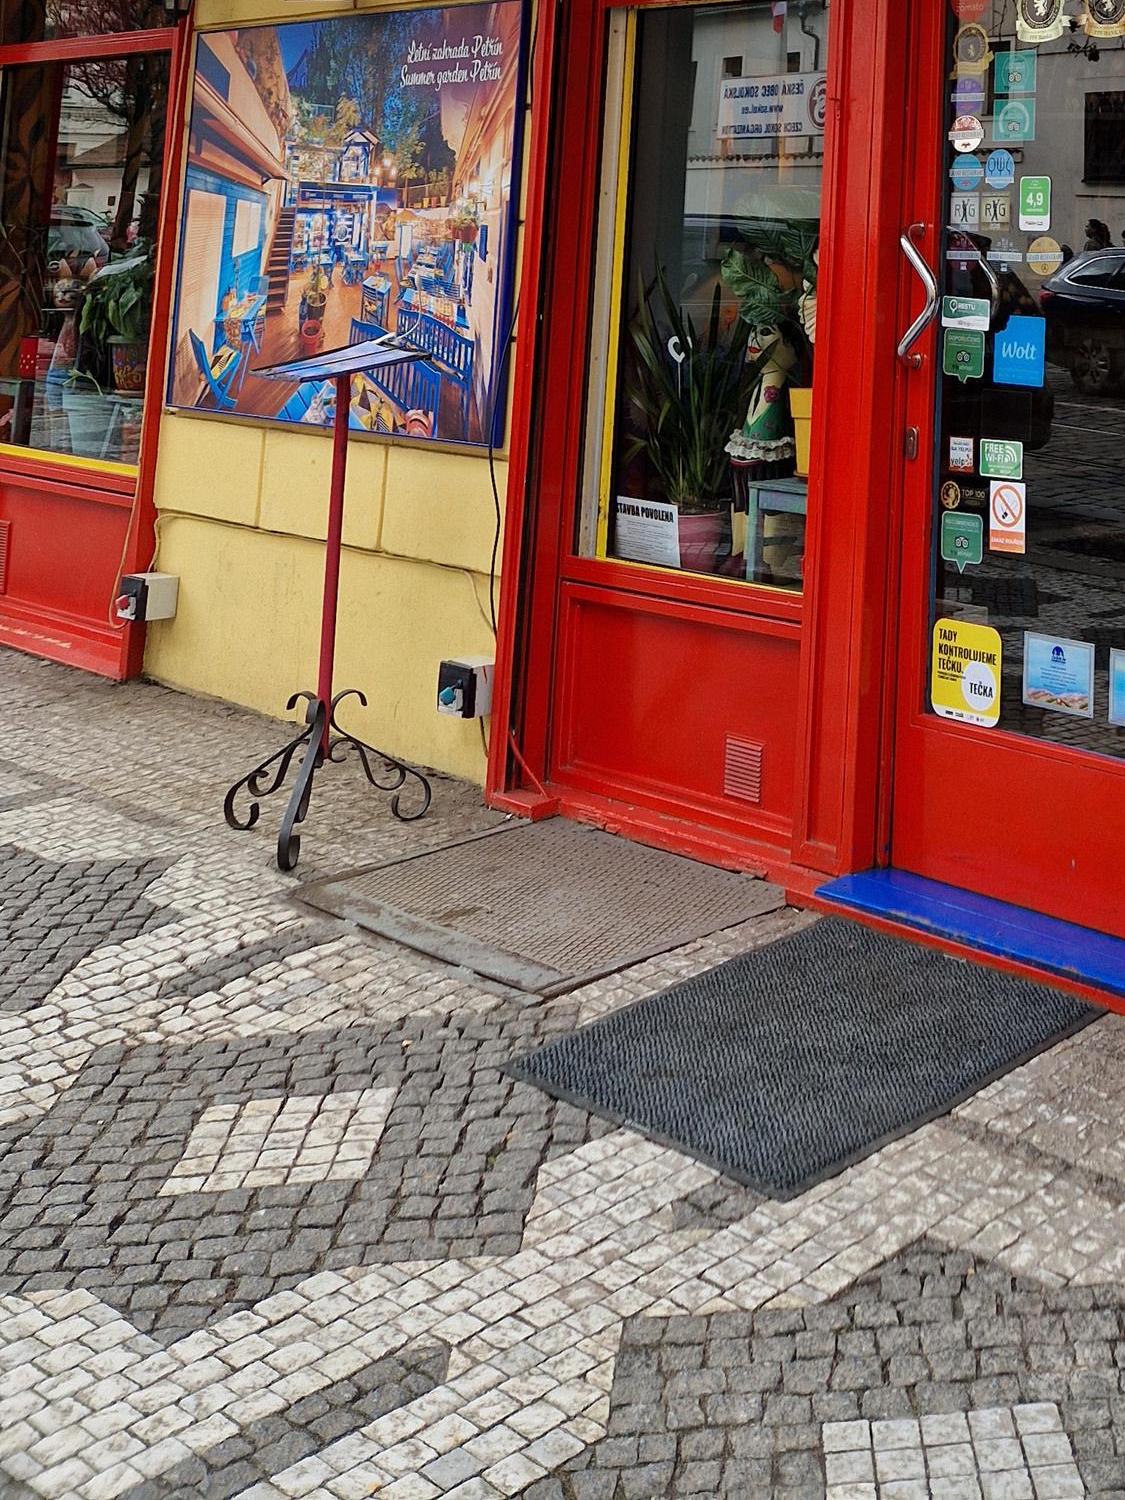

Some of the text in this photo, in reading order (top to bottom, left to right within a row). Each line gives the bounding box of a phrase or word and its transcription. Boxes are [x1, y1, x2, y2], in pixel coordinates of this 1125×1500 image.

[431, 37, 470, 61] zahrada
[471, 34, 504, 59] Petřín
[400, 59, 502, 92] Summer garden Petřín
[1025, 191, 1045, 208] 4,9
[1001, 340, 1038, 361] Wolt
[984, 443, 1005, 454] FREE
[961, 489, 975, 498] TOP
[616, 502, 674, 524] STAVBA POVOLENA
[938, 627, 958, 643] TADY
[938, 642, 998, 667] KONTROLUJEME
[937, 655, 965, 675] TEČKU.
[969, 681, 994, 699] TEČKA
